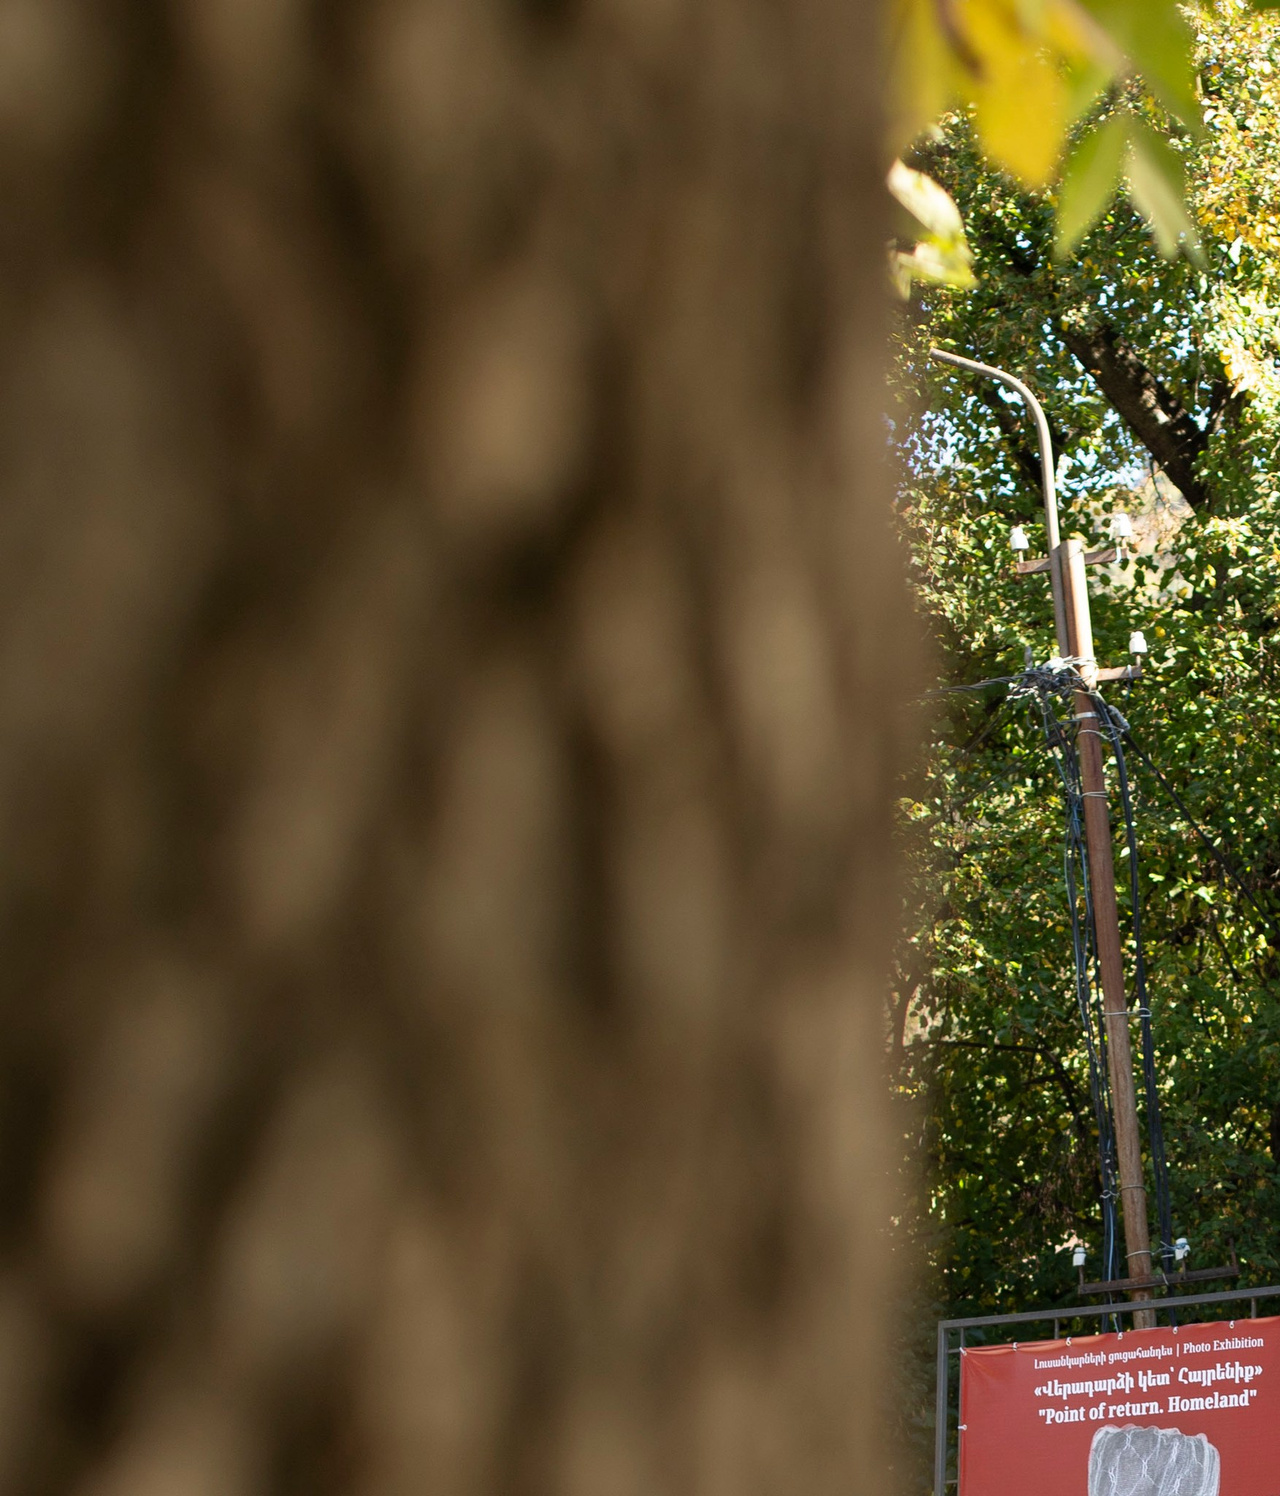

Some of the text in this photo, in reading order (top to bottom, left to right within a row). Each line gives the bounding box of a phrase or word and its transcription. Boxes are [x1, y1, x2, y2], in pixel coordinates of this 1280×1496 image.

[1183, 1341, 1211, 1354] Photo
[1213, 1336, 1264, 1351] Exhibition
[1038, 1388, 1258, 1425] "Point of return. Homeland"
